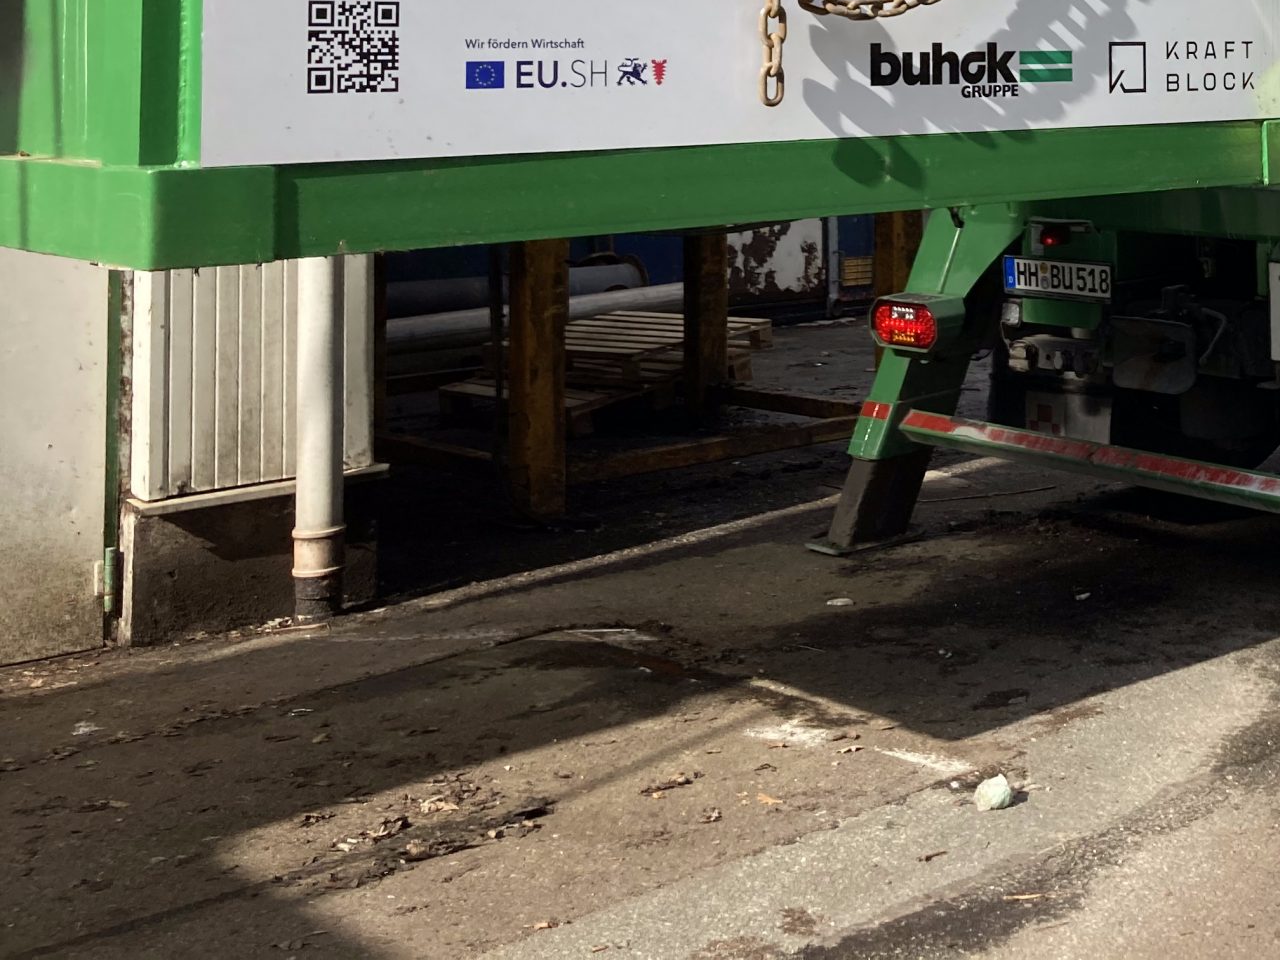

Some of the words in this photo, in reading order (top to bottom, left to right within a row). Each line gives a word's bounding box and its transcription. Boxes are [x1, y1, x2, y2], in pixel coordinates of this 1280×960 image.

[465, 39, 485, 49] Wir
[487, 38, 528, 49] fördern
[531, 38, 585, 49] Wirtschaft
[1165, 41, 1254, 60] KRAFT
[516, 59, 608, 89] EU.SH
[870, 42, 1018, 87] buhck
[961, 84, 1019, 98] GRUPPE
[1166, 71, 1255, 92] BLOCK
[1016, 261, 1039, 288] HH
[1076, 266, 1110, 294] 518
